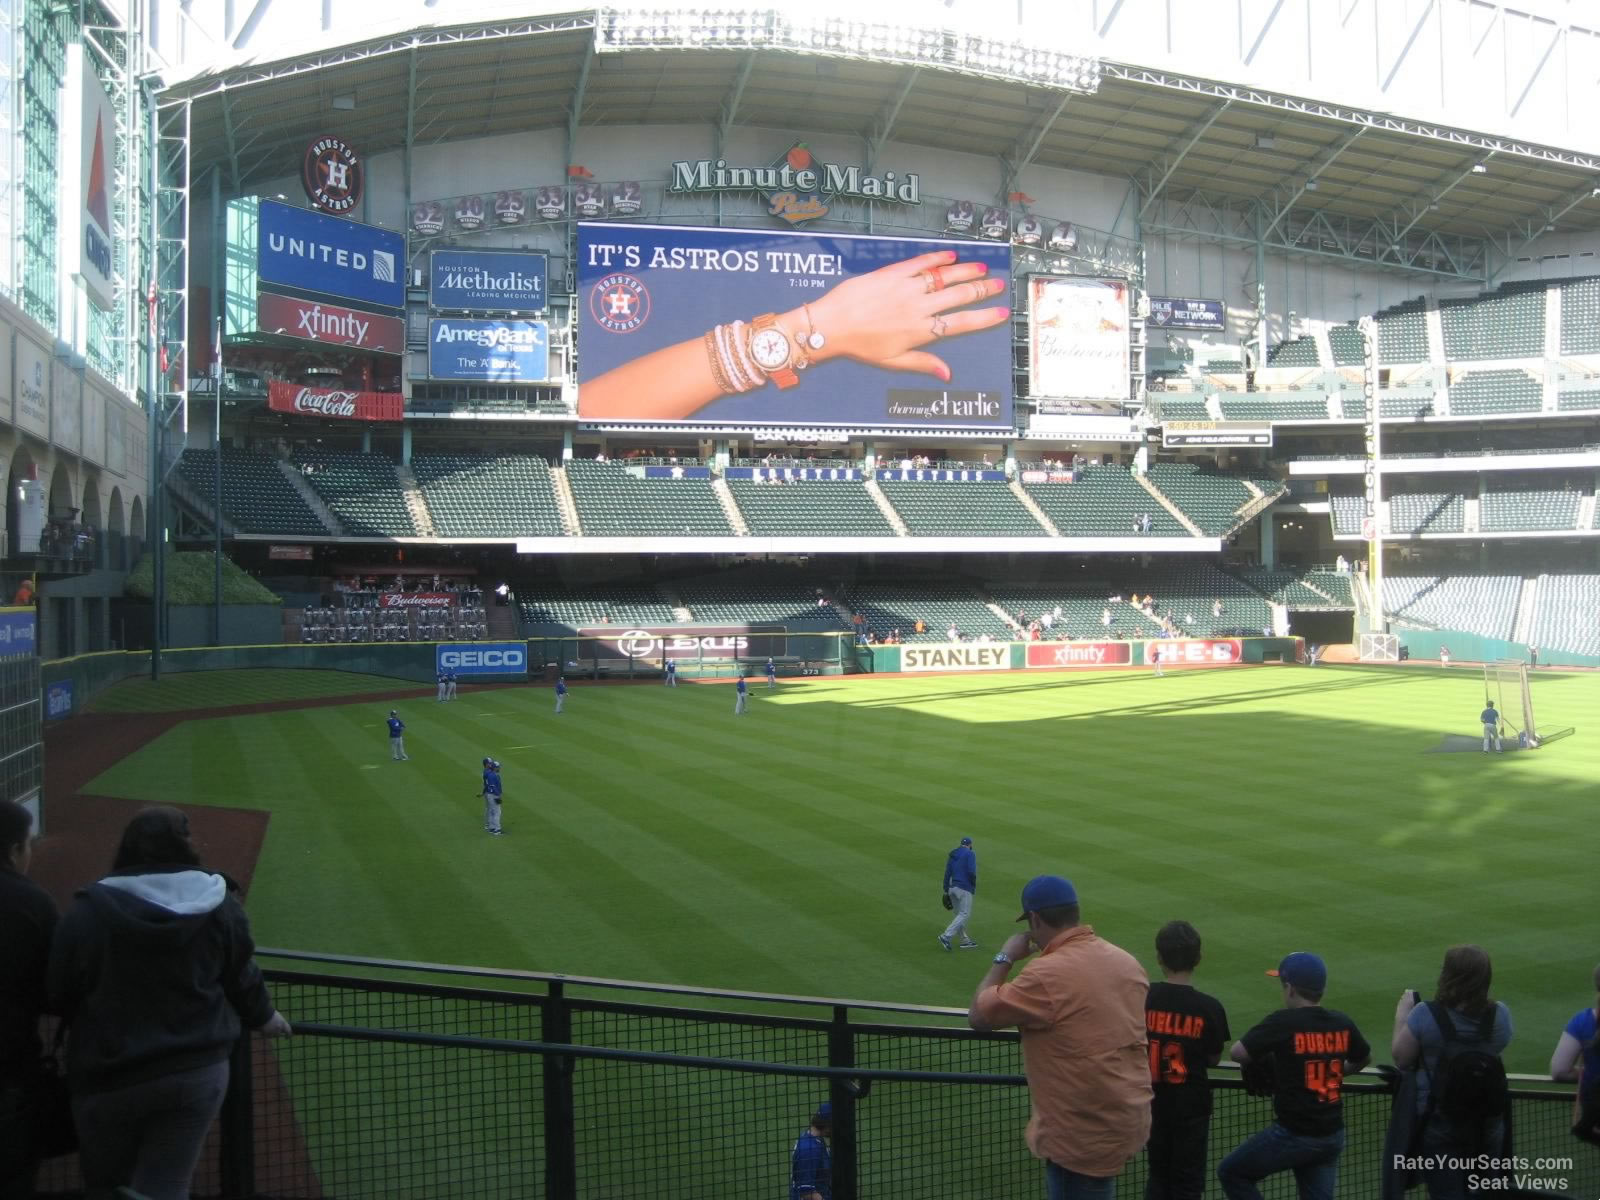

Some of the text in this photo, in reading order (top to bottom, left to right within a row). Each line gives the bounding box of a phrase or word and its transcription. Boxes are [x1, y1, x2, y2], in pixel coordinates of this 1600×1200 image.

[313, 139, 357, 165] HOUSTON
[327, 160, 348, 189] H
[672, 159, 921, 204] Minute Maid
[315, 188, 354, 209] ASTROS
[269, 233, 367, 270] UNITED
[588, 244, 843, 276] IT'S ASTROS TIME!
[439, 271, 542, 292] Methodist
[599, 276, 643, 294] HOUSTON
[789, 278, 825, 288] 7:10 PM
[609, 293, 632, 314] H
[1187, 302, 1206, 312] MLB
[599, 316, 642, 331] ASTROS
[1174, 310, 1217, 320] NETWORK
[298, 305, 369, 345] xfinity
[457, 358, 477, 367] The
[931, 391, 1000, 416] charlie
[754, 433, 849, 442] DAKTRONICS
[901, 470, 983, 480] ASTROS
[384, 593, 450, 608] Budweiser
[657, 635, 748, 650] LEXUS
[441, 650, 523, 668] GEICO
[905, 646, 1006, 667] STANLEY
[1054, 643, 1105, 662] xfinity
[1156, 643, 1233, 661] H-E-B
